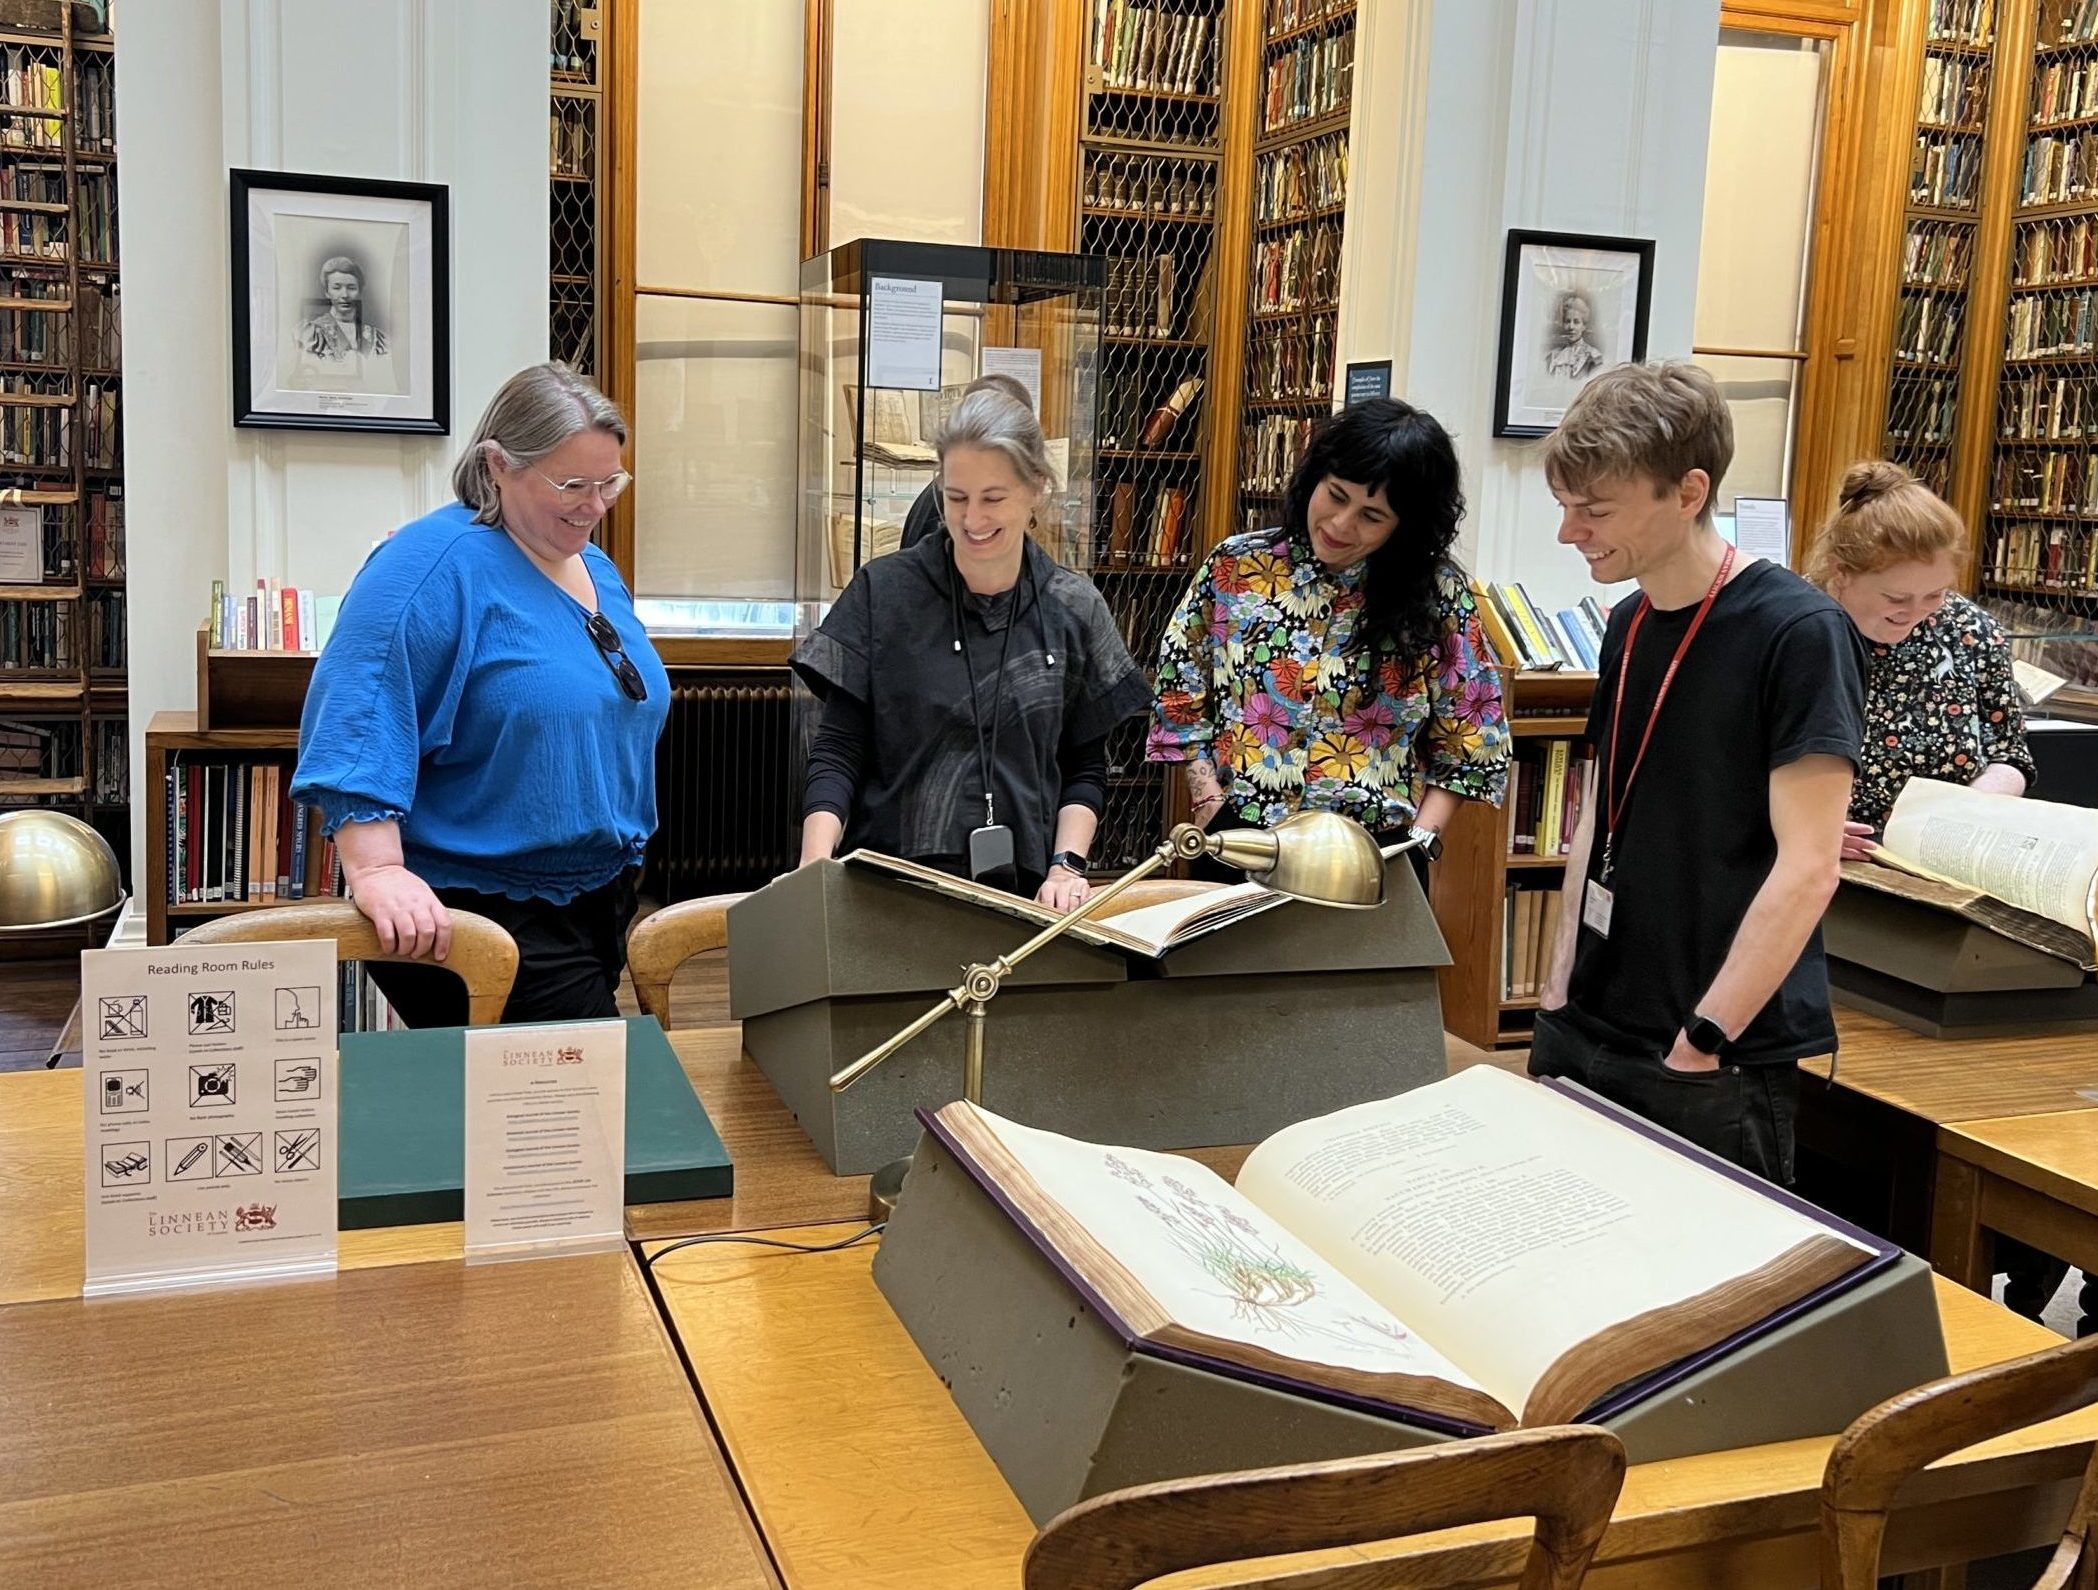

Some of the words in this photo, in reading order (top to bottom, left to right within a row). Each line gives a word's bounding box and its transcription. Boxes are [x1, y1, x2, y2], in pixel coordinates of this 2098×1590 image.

[874, 282, 917, 294] Background
[147, 962, 199, 976] Reading
[202, 961, 238, 972] Room
[241, 959, 275, 971] Rules
[502, 1057, 553, 1066] SOCIETY
[149, 1210, 229, 1226] LINNEAN
[149, 1220, 229, 1236] SOCIETY
